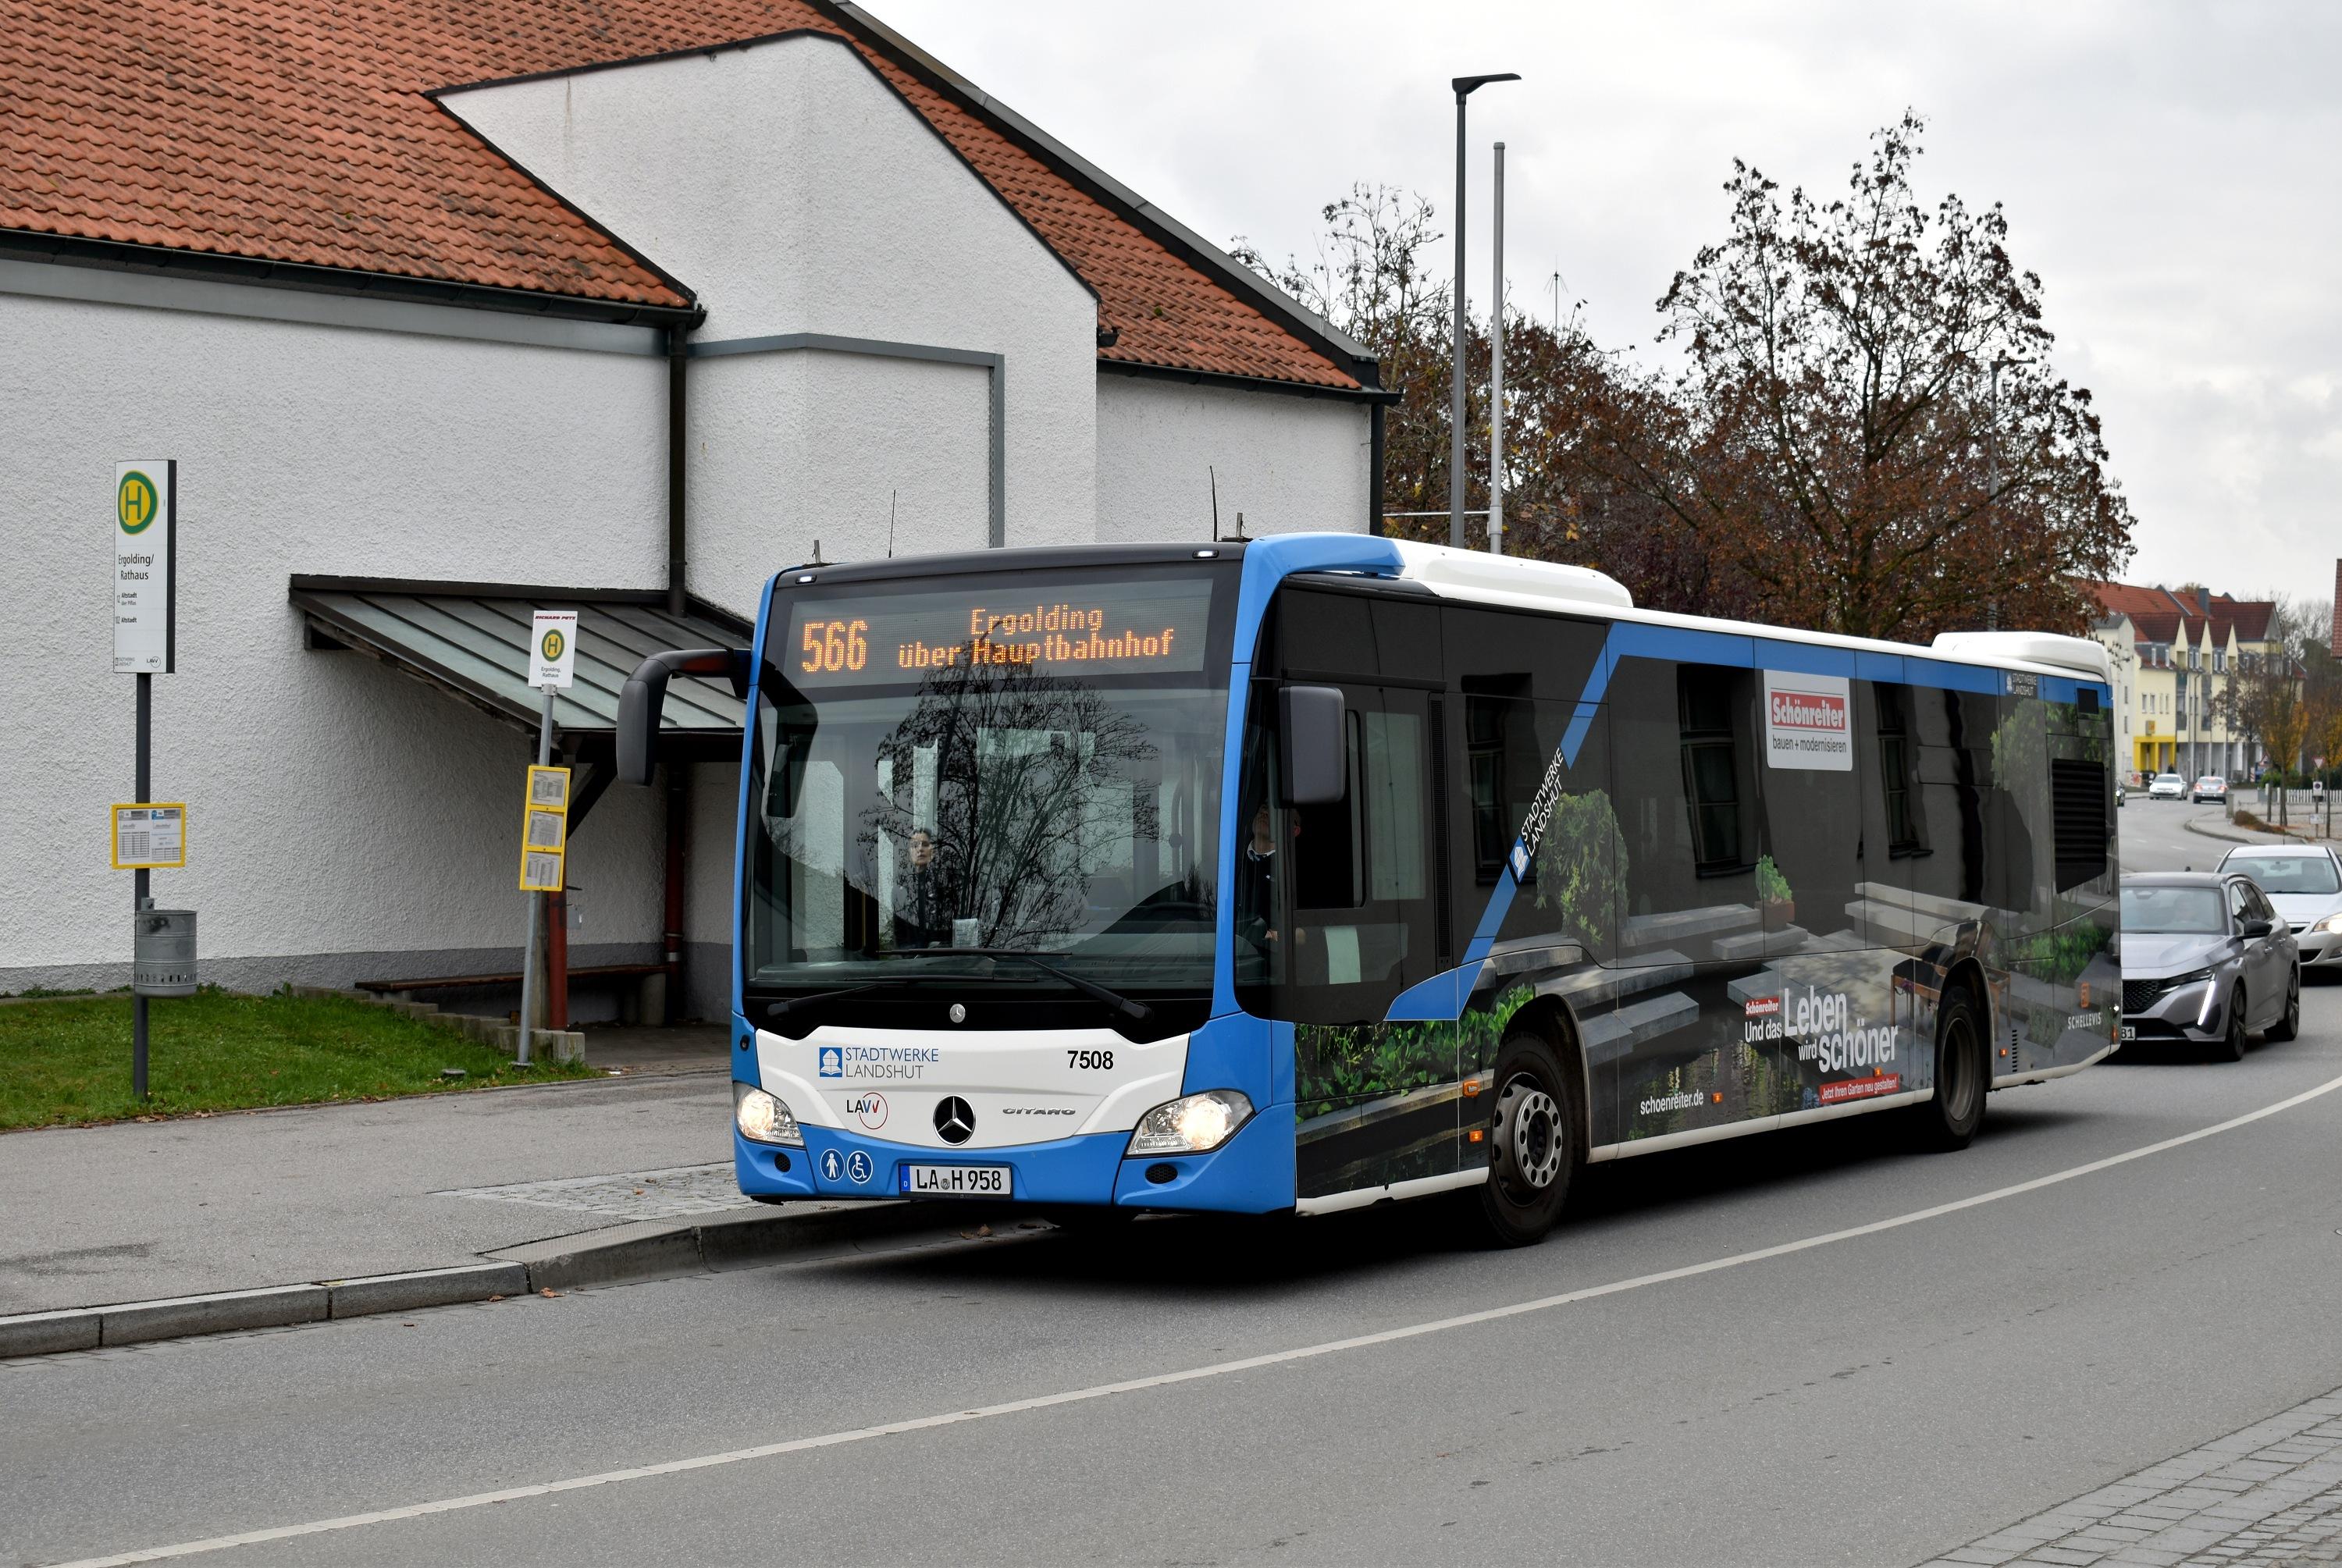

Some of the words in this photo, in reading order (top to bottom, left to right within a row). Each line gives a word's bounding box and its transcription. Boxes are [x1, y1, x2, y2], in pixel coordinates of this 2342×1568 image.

[126, 486, 142, 521] H
[118, 553, 154, 567] Ergolding/
[120, 569, 149, 580] Rathaus
[970, 603, 1103, 636] Ergolding
[547, 638, 559, 653] H
[802, 620, 868, 673] 566
[899, 641, 962, 669] über
[971, 628, 1174, 667] Hauptbahnhof
[1772, 696, 1844, 727] Schönreiter
[1773, 734, 1793, 750] bauen
[1799, 738, 1847, 753] modernisieren
[1522, 747, 1564, 841] STADTWERKE
[1527, 774, 1562, 857] LANDSHUT
[1745, 999, 1779, 1015] Schönreiter
[1745, 1019, 1764, 1043] Und
[1765, 1019, 1782, 1040] das
[1784, 985, 1847, 1037] Leben
[2068, 1012, 2102, 1029] SCHELLEVIS
[845, 1047, 939, 1063] STADTWERKE
[1798, 1039, 1817, 1061] wird
[1818, 1015, 1899, 1073] schöner
[845, 1064, 924, 1079] LANDSHUT
[1067, 1050, 1114, 1070] 7508
[1821, 1087, 1834, 1100] Jetzt
[1834, 1086, 1847, 1097] Ihren
[1847, 1083, 1864, 1095] Garten
[1864, 1083, 1874, 1093] neu
[1874, 1076, 1897, 1094] gestalten!
[1002, 1107, 1077, 1115] CITARO
[1640, 1088, 1704, 1115] schoenreiter.de
[916, 1169, 939, 1189] LA
[951, 1170, 963, 1190] H
[967, 1170, 1002, 1191] 958
